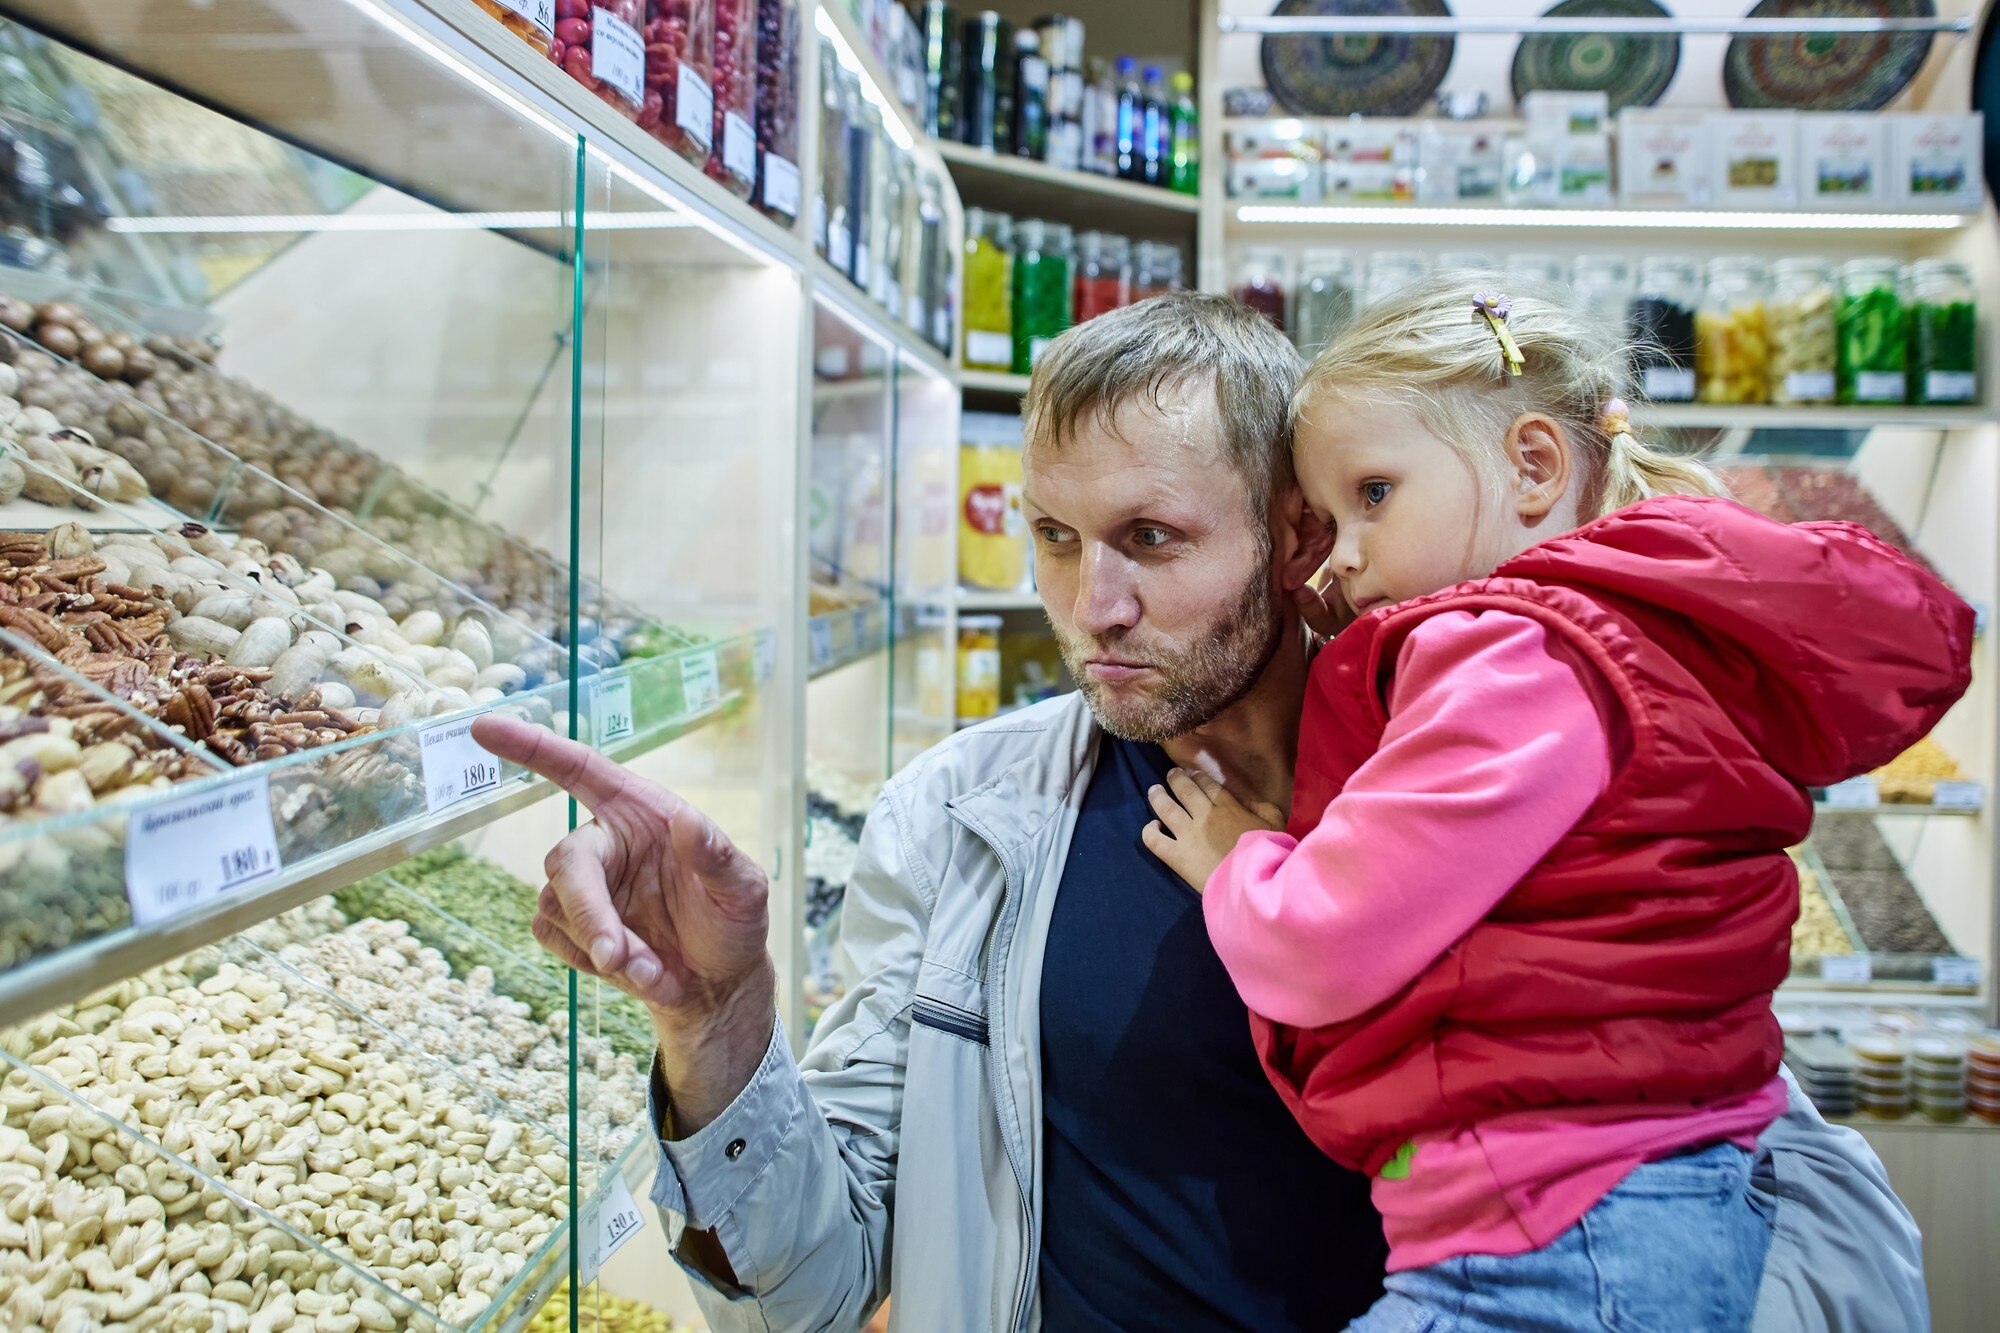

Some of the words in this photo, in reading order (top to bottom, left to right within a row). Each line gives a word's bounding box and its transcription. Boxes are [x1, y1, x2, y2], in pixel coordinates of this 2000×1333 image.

[538, 1, 550, 24] 86
[608, 713, 621, 732] 124
[424, 733, 444, 747] Пекан
[464, 763, 485, 788] 180
[221, 846, 259, 882] 180
[608, 1212, 628, 1239] 130
